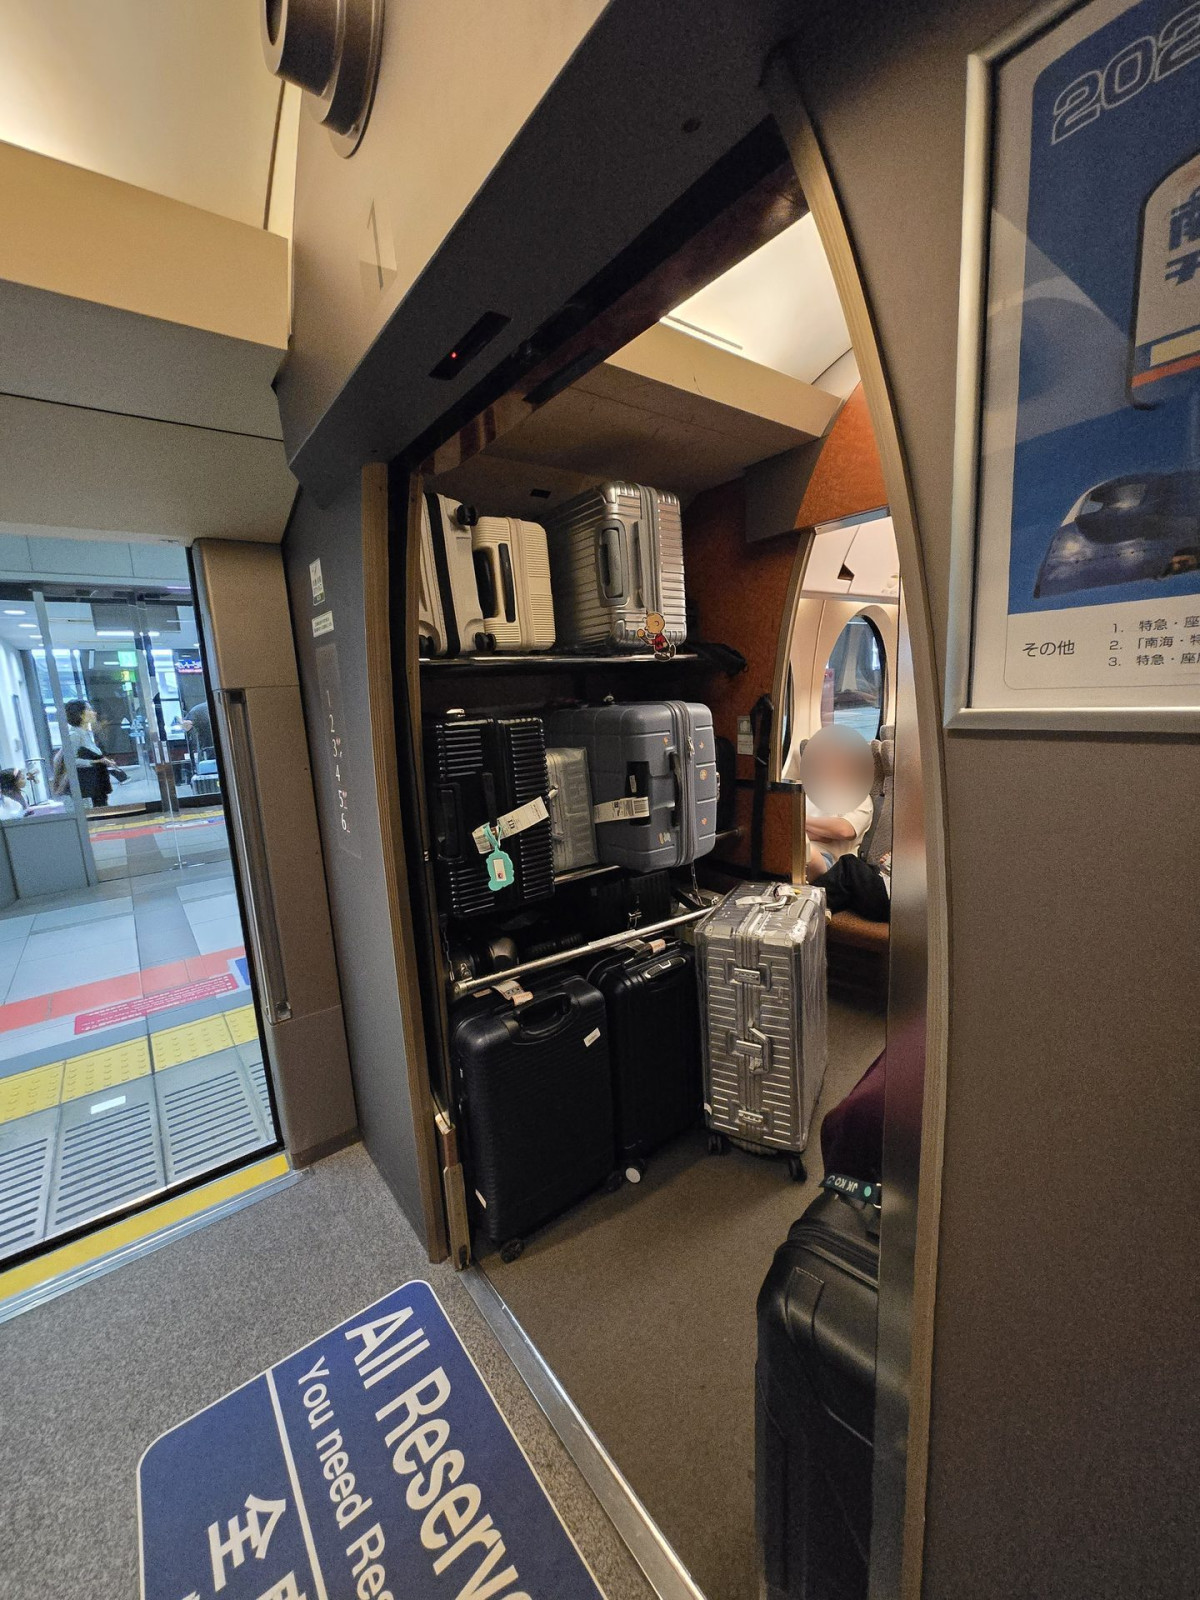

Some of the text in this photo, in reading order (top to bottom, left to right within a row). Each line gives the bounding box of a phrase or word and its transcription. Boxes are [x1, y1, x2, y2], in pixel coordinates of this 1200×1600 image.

[1112, 623, 1124, 634] 1.
[1022, 640, 1075, 657] その他
[1109, 640, 1123, 650] 2.
[1108, 652, 1200, 667] 3. 特急・座
[328, 714, 336, 733] 2
[337, 789, 344, 808] 5
[340, 812, 347, 831] 6
[298, 1355, 334, 1430] You
[316, 1428, 373, 1530] need
[344, 1306, 534, 1600] All Reserv
